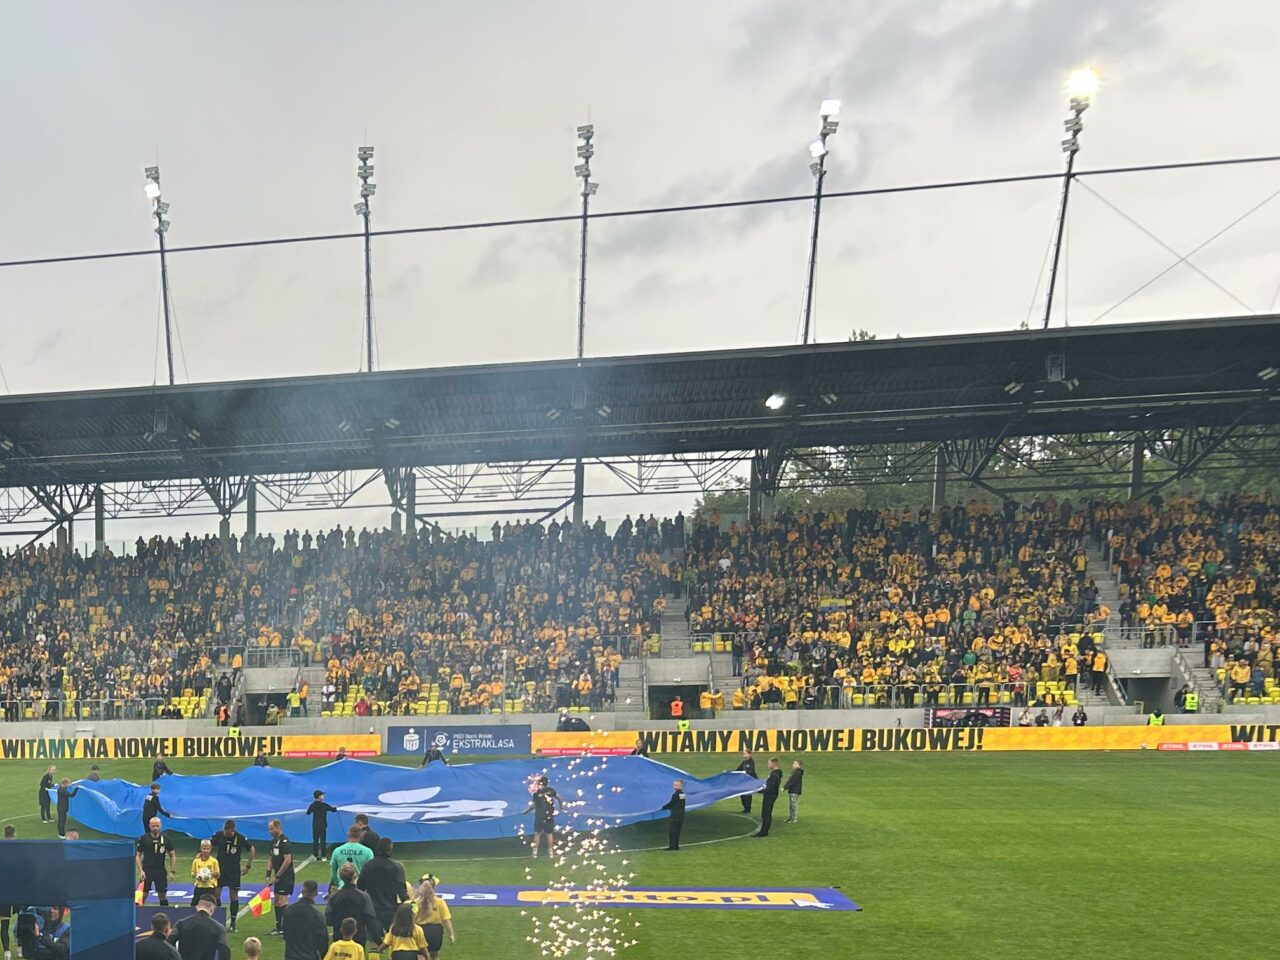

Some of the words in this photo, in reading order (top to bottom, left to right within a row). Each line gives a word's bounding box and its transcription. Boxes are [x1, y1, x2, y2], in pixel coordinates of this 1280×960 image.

[1, 739, 78, 758] WITAMY
[83, 739, 108, 758] NA
[113, 738, 177, 758] NOWEJ
[183, 737, 283, 757] BUKOWEJ!
[453, 739, 514, 749] EKSTRAKLASA
[638, 730, 732, 752] WITAMY
[738, 730, 773, 752] NA
[777, 729, 854, 751] NOWEJ
[861, 728, 983, 750] BUKOWEJ!
